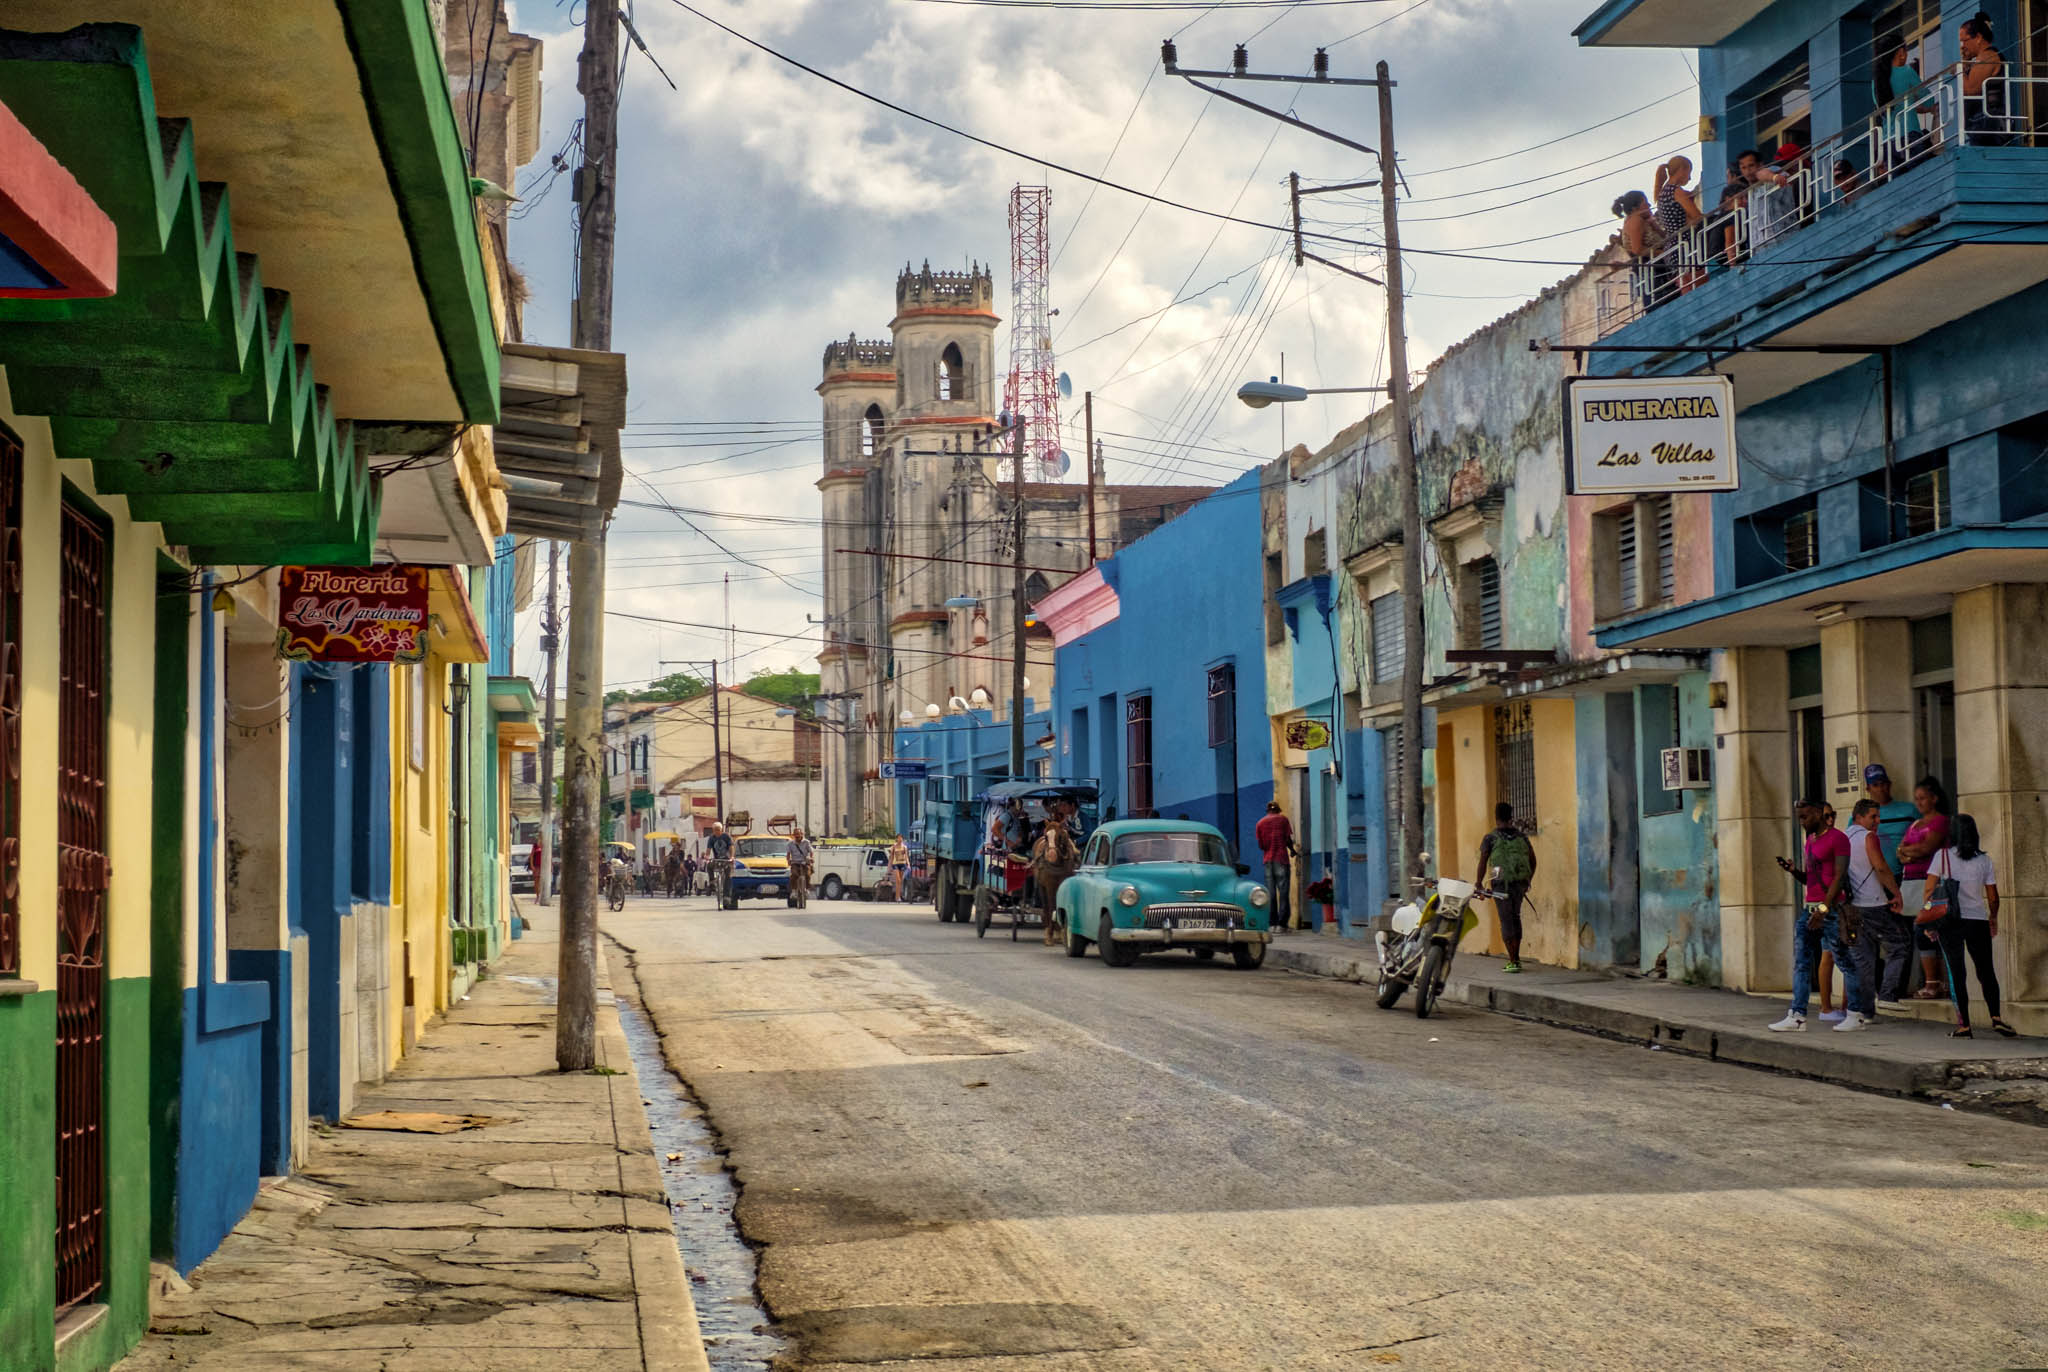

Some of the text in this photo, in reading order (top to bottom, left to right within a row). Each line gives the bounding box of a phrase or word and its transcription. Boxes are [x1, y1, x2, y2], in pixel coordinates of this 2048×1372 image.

[1584, 397, 1720, 422] FUNERARIA
[1597, 441, 1716, 467] Las Villas
[301, 571, 409, 594] Floreria
[285, 597, 423, 636] Las Gardenias
